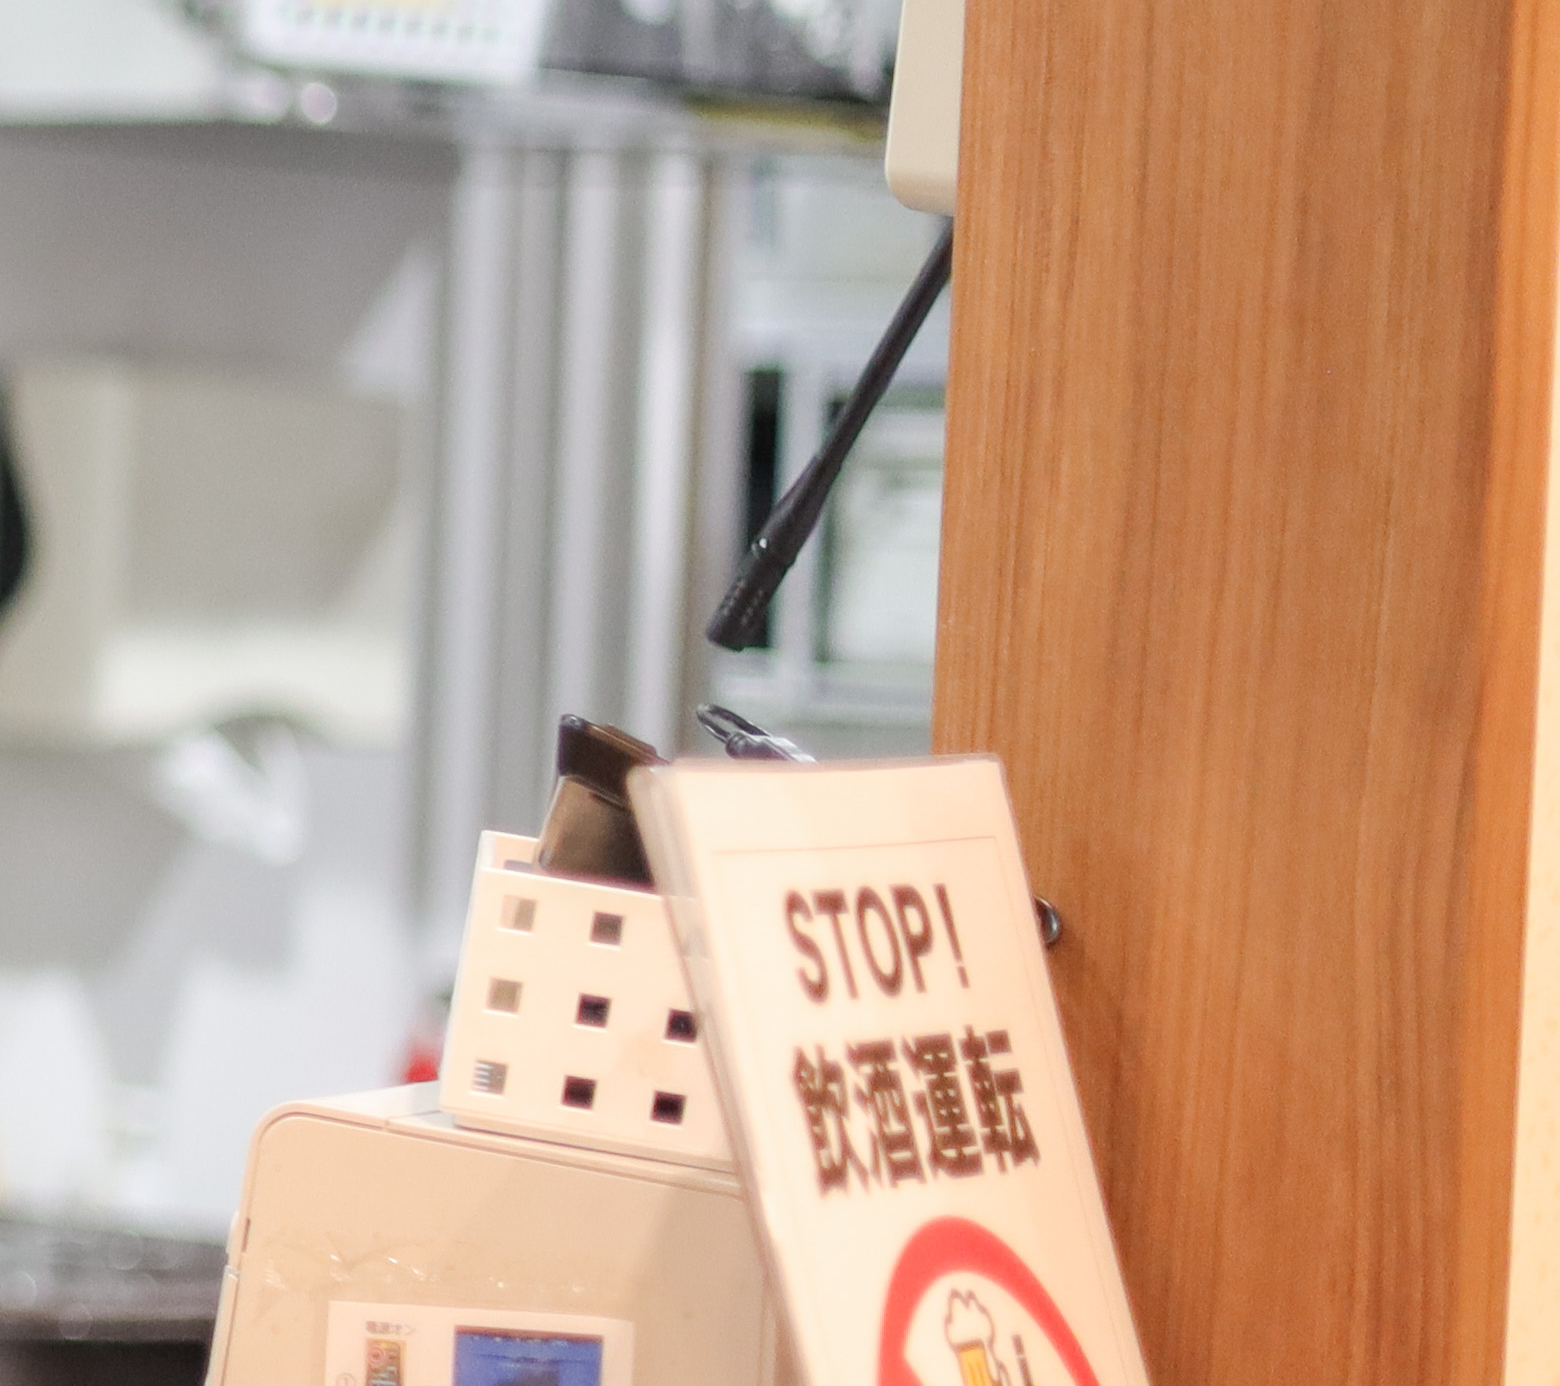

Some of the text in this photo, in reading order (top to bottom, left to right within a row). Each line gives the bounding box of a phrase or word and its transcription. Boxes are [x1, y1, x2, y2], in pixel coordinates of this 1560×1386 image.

[784, 883, 970, 1004] STOP!
[791, 1023, 1041, 1197] 飲酒運転
